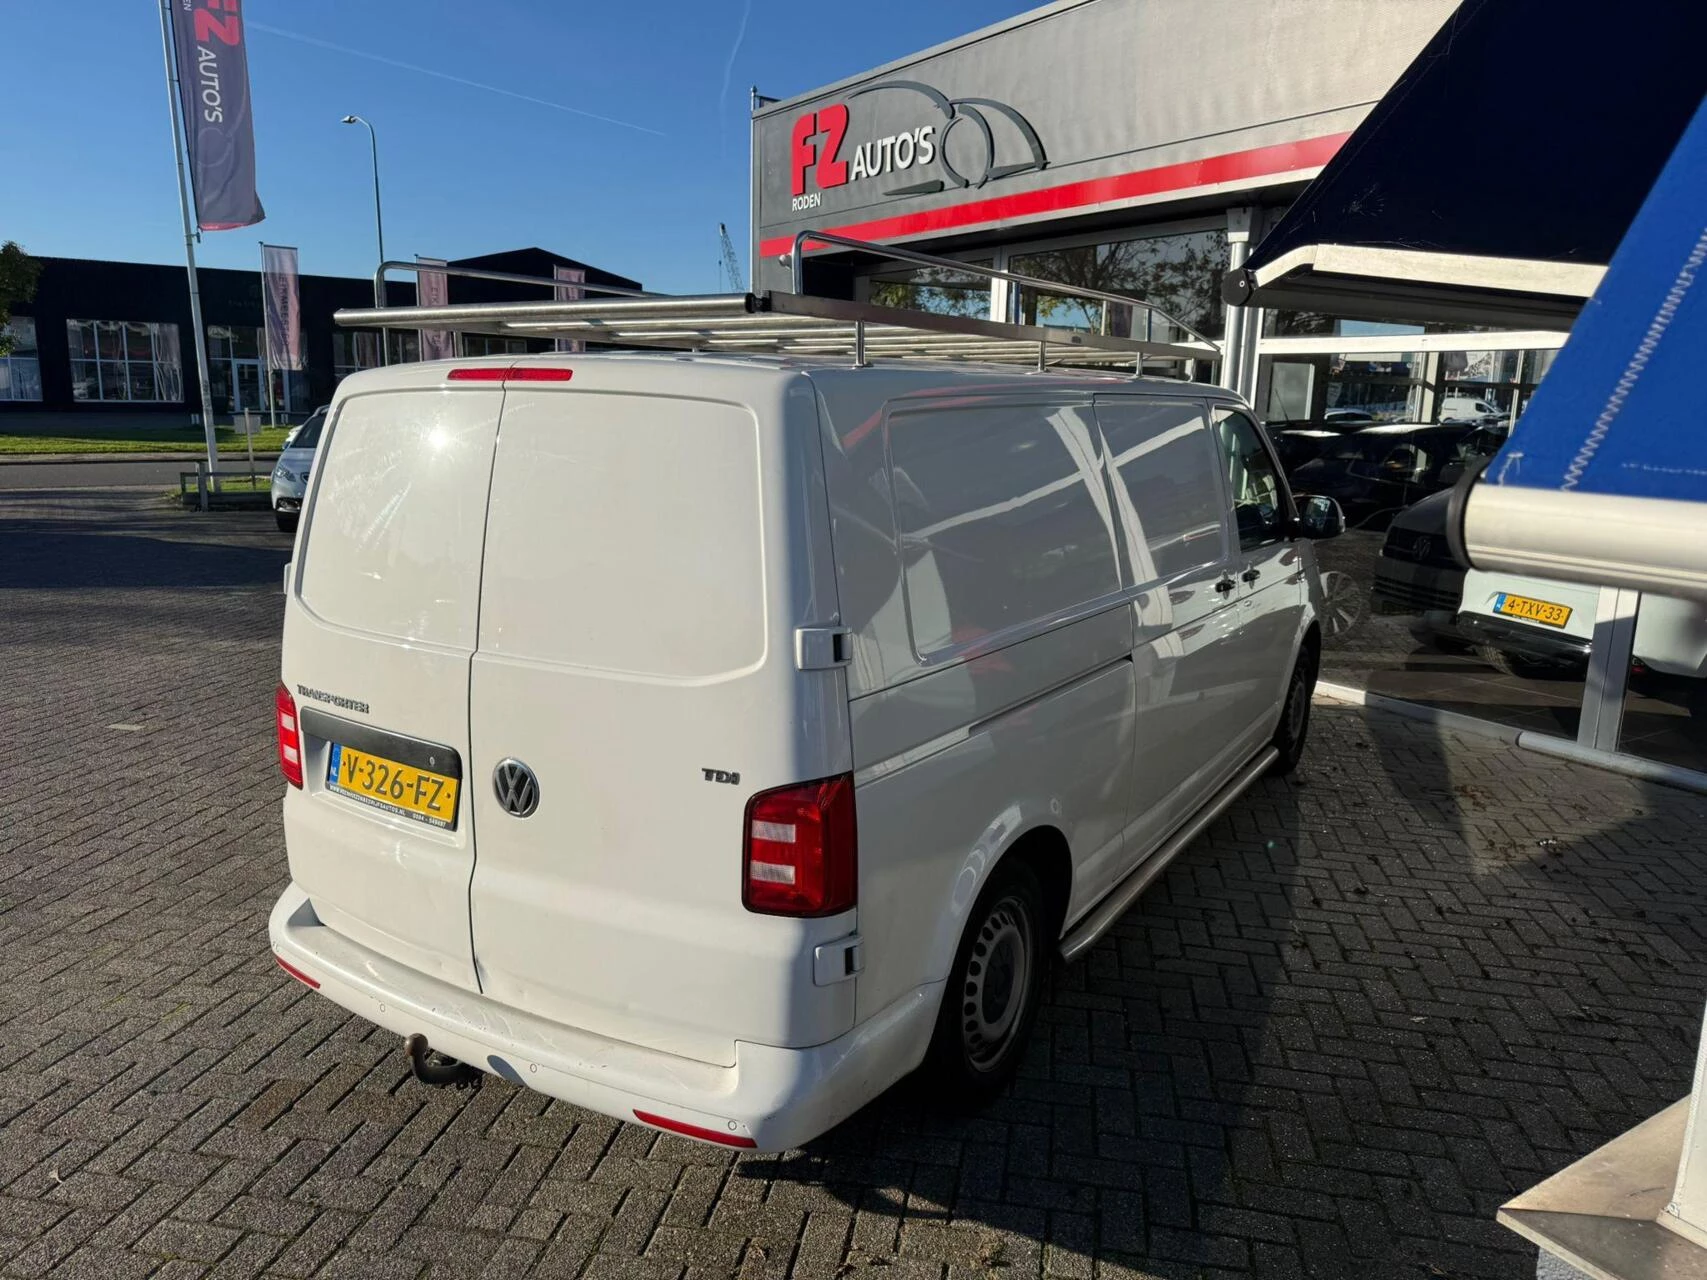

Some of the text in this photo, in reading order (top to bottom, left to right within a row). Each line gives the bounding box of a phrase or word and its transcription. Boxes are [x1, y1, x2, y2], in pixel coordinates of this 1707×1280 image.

[197, 45, 223, 123] AUTO'S
[790, 103, 935, 196] FZ AUTO'S
[791, 193, 821, 212] RODEN
[1508, 599, 1563, 621] 4-TXV-33
[297, 684, 370, 714] TRANSPORTER
[347, 753, 445, 811] V-326-FZ
[702, 768, 740, 785] TDI
